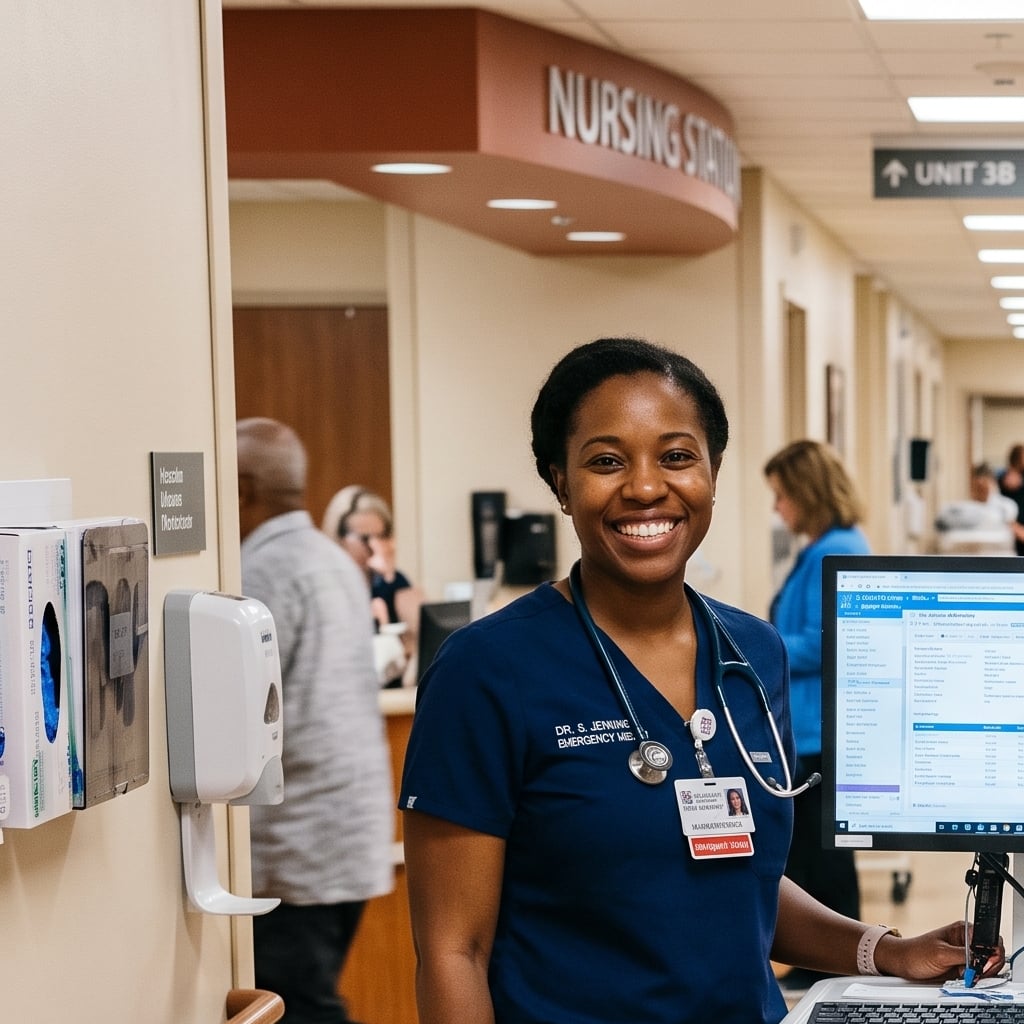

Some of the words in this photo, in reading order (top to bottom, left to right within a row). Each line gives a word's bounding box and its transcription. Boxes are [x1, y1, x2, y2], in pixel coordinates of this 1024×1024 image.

[548, 65, 681, 169] NURSING
[915, 160, 976, 186] UNIT
[981, 160, 1017, 186] 3B
[555, 725, 575, 736] DR.
[577, 723, 588, 733] S.
